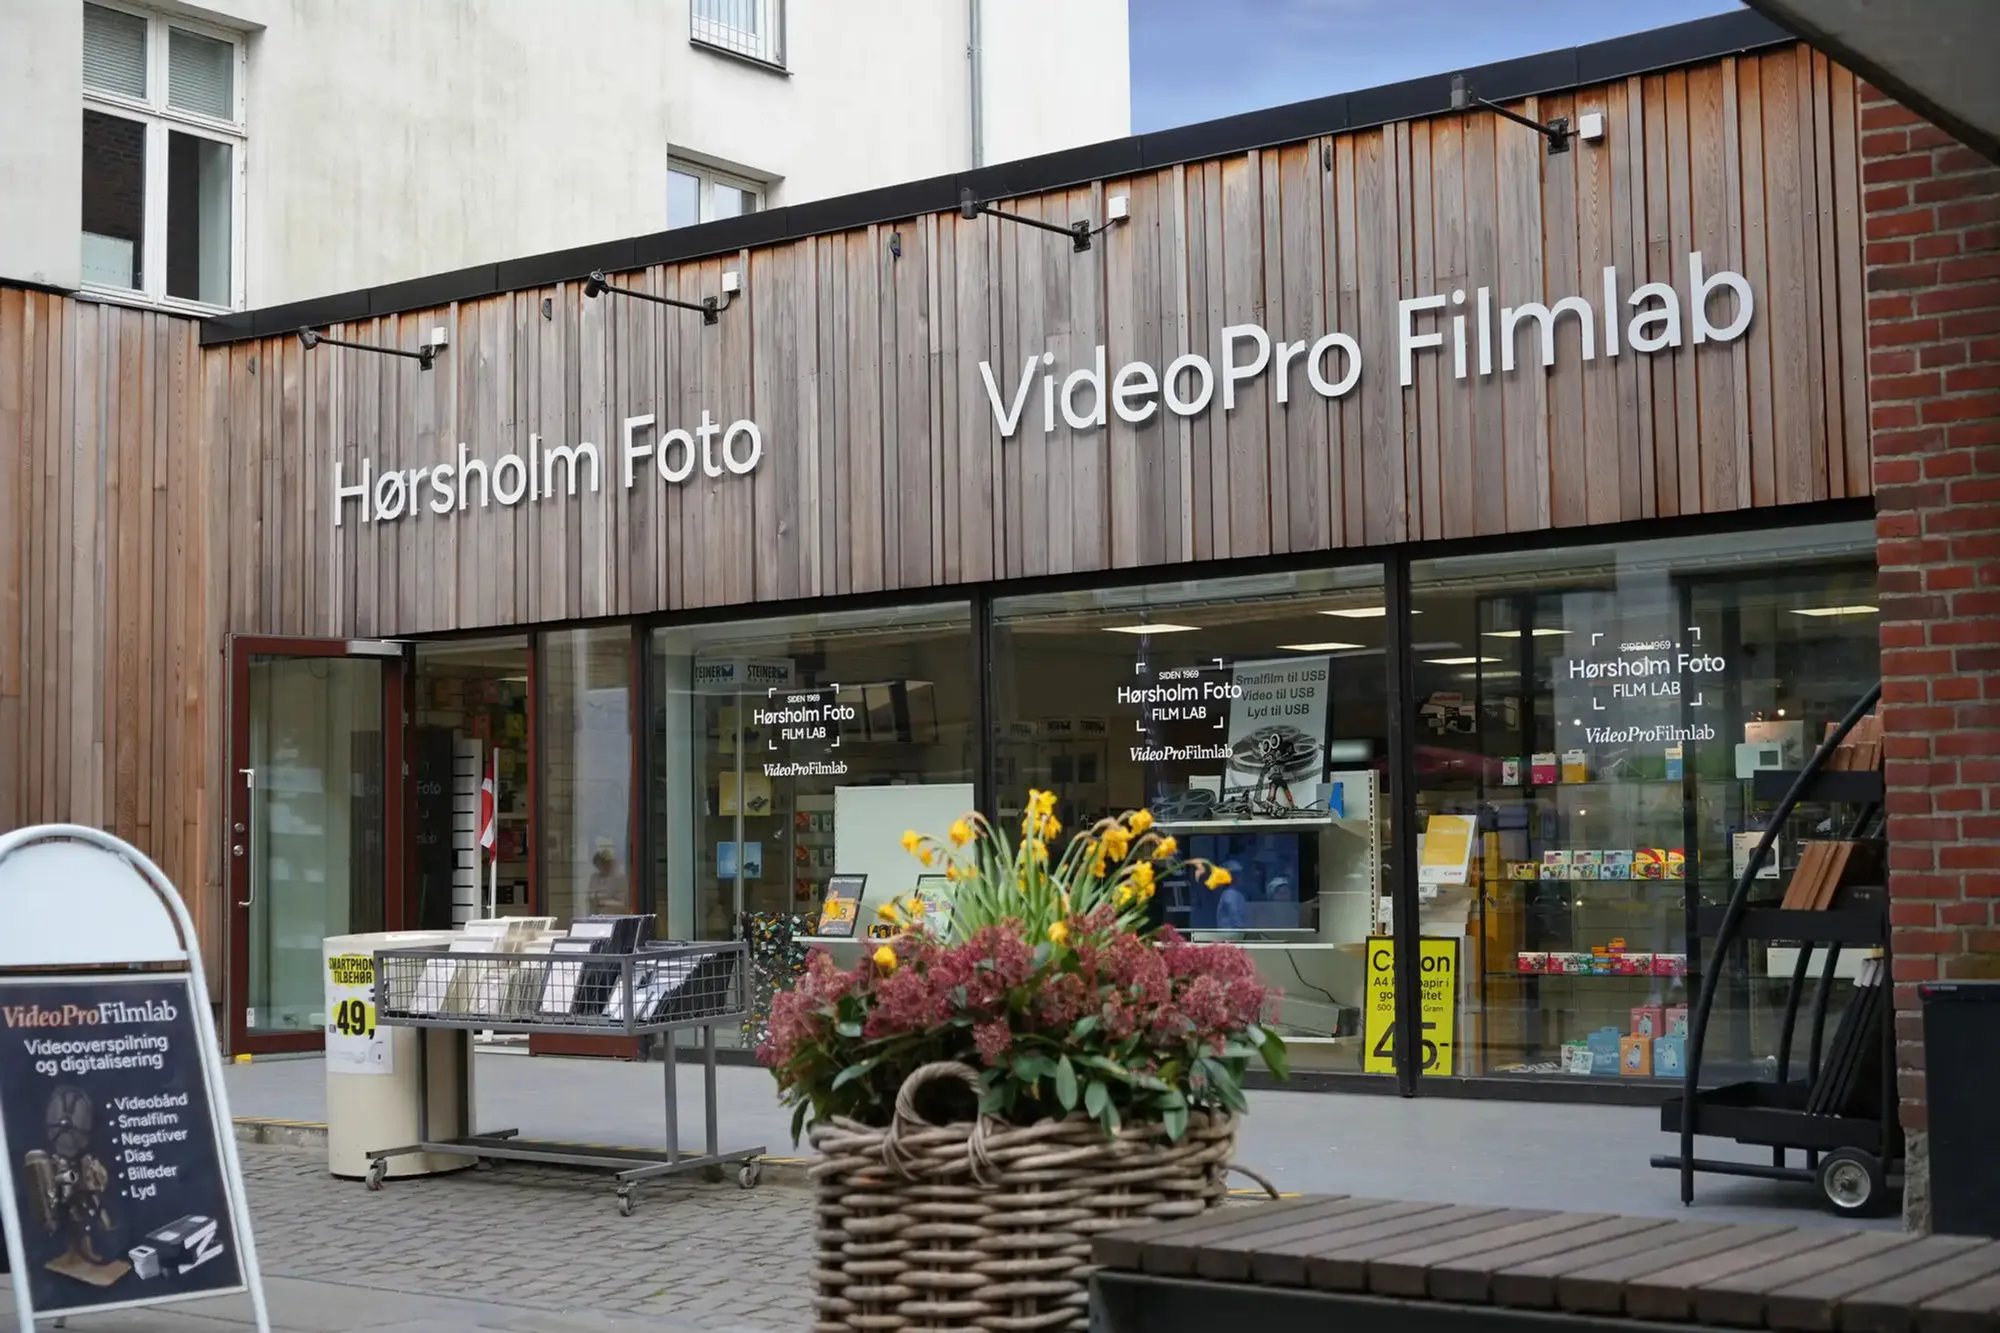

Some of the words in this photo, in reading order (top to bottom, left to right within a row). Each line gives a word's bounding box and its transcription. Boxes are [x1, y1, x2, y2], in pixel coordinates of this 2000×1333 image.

[979, 323, 1362, 437] VideoPro
[1398, 251, 1755, 387] Filmlab
[334, 432, 599, 526] Hørsholm
[623, 410, 762, 488] Foto
[1652, 640, 1671, 650] 1969
[1158, 671, 1181, 680] SIDEN
[1183, 670, 1199, 678] 1969
[1569, 656, 1669, 679] Hørsholm
[1677, 653, 1726, 674] Foto
[1236, 671, 1284, 685] Smalfilm
[1288, 671, 1299, 683] til
[1301, 670, 1327, 682] USB
[1117, 683, 1199, 704] Hørsholm
[1204, 681, 1242, 700] Foto
[1241, 689, 1273, 701] Video
[1276, 688, 1287, 700] til
[1289, 686, 1315, 699] USB
[1612, 683, 1647, 698] FILM
[1651, 681, 1681, 696] LAB
[753, 706, 819, 725] Hørsholm
[823, 704, 855, 721] Foto
[1152, 708, 1179, 721] FILM
[1182, 707, 1207, 720] LAB
[1247, 705, 1268, 718] Lyd
[1271, 704, 1281, 716] til
[1284, 702, 1310, 715] USB
[781, 728, 804, 740] FILM
[806, 727, 826, 739] LAB
[1585, 723, 1715, 744] VideoProFilmlab
[1130, 744, 1233, 762] VideoProFilmlab
[763, 759, 848, 777] VideoProFilmlab
[328, 957, 375, 971] SMARTPHON
[1373, 949, 1450, 972] Con
[334, 970, 373, 984] TILBEHØR
[1373, 977, 1388, 987] A4
[2, 1000, 178, 1029] VideoProFilmlab
[1423, 1004, 1444, 1013] Gram
[24, 1033, 169, 1055] Videooverspilning
[35, 1059, 58, 1076] og
[60, 1052, 164, 1075] digitalisering
[114, 1092, 188, 1110] Videobånd
[118, 1111, 179, 1129] Smalfilm
[121, 1129, 188, 1148] Negativer
[124, 1148, 155, 1164] Dias
[127, 1165, 179, 1181] Billeder
[130, 1182, 157, 1201] Lyd
